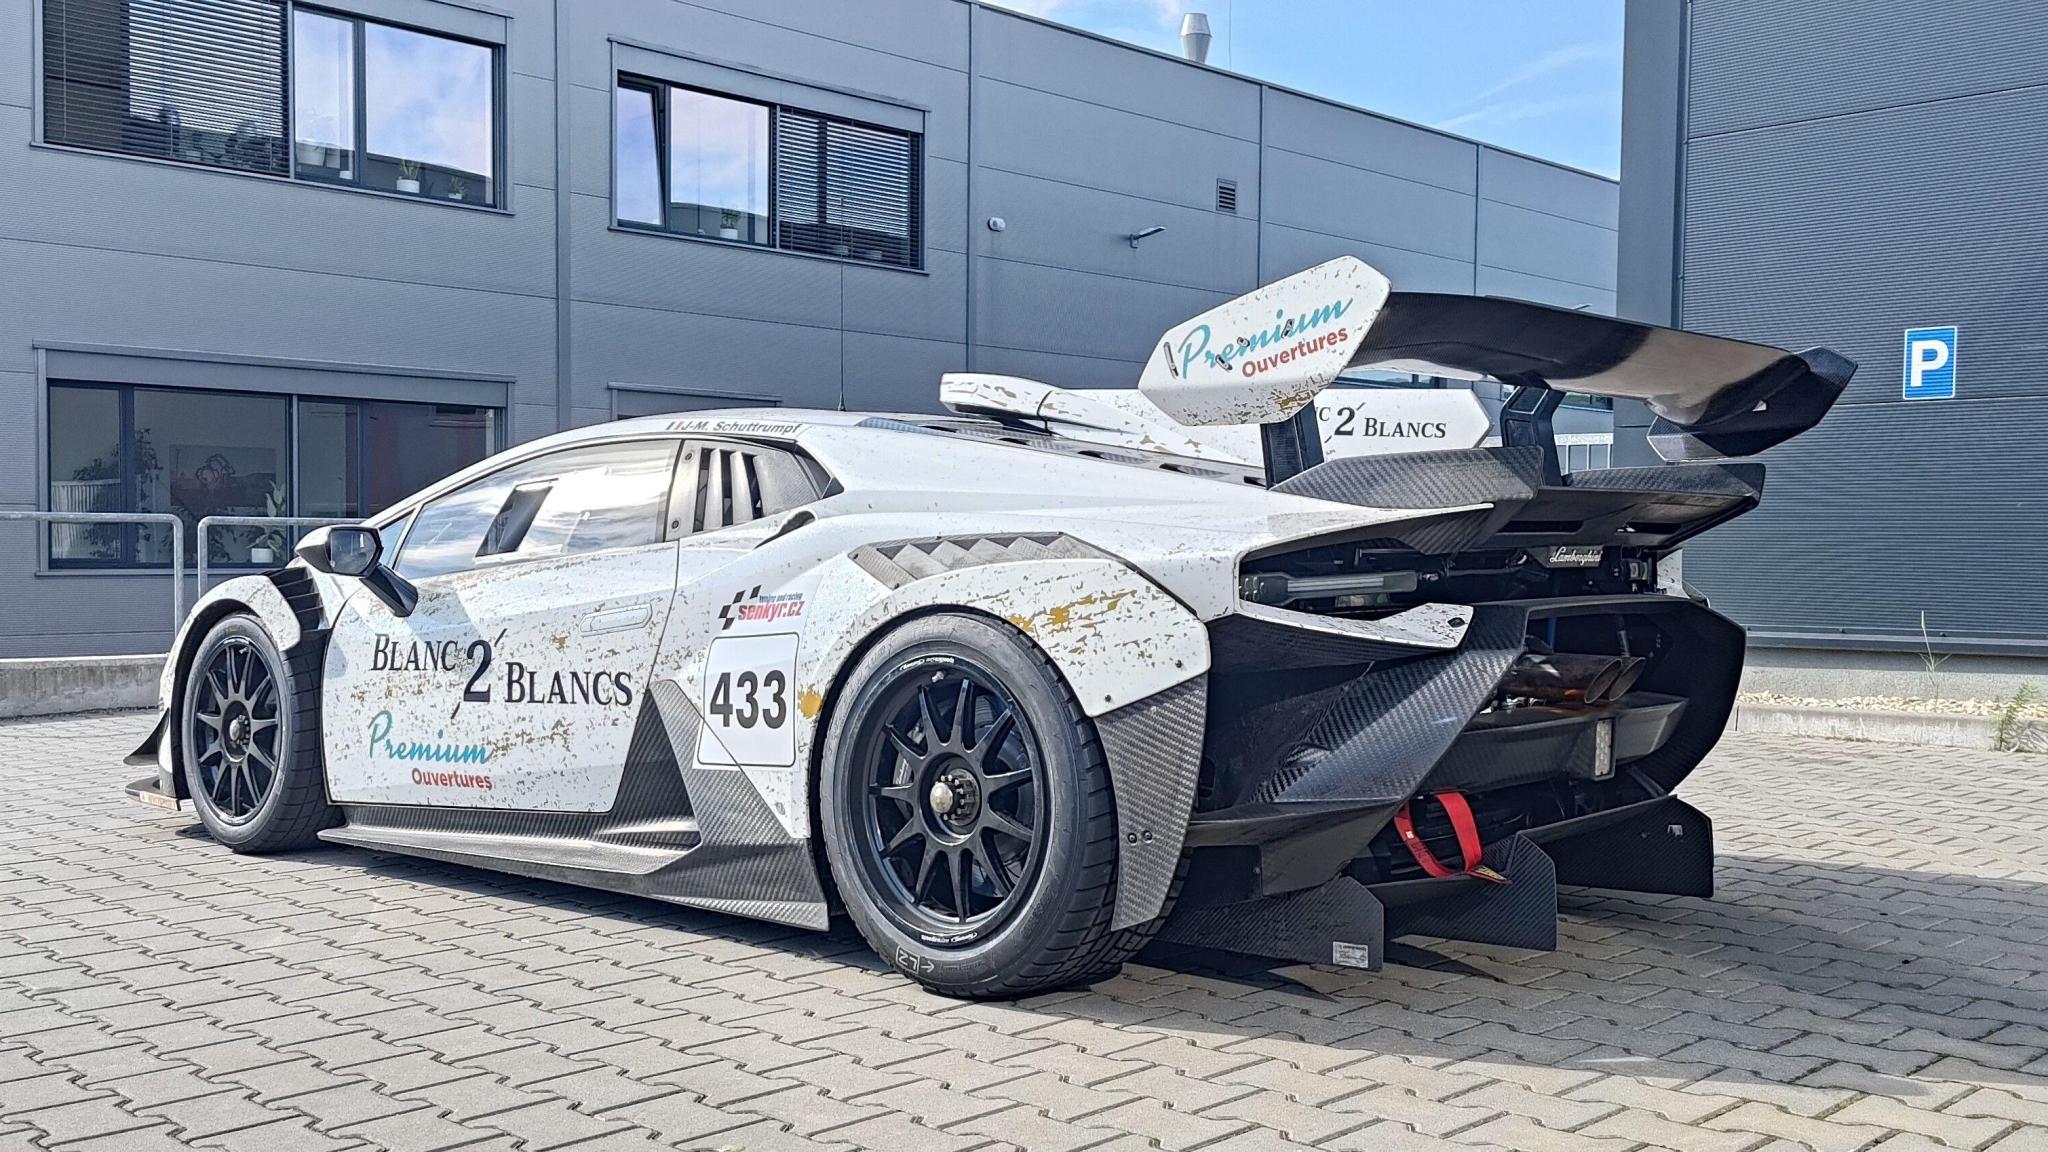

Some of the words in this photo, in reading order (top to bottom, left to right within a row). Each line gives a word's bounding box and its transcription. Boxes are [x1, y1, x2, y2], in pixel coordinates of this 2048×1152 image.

[1178, 298, 1354, 379] Premium
[1241, 327, 1348, 377] Ouvertures
[1910, 339, 1949, 387] P
[713, 420, 802, 434] Schuttrumpf
[1334, 406, 1356, 436] 2
[1362, 417, 1447, 438] BLANCS
[738, 600, 805, 622] senkyr.cz
[371, 633, 459, 671] BLANC
[463, 639, 493, 703] 2
[505, 661, 633, 706] BLANCS
[709, 669, 787, 730] 433
[367, 709, 494, 765] Premium
[411, 767, 493, 790] Ouvertures
